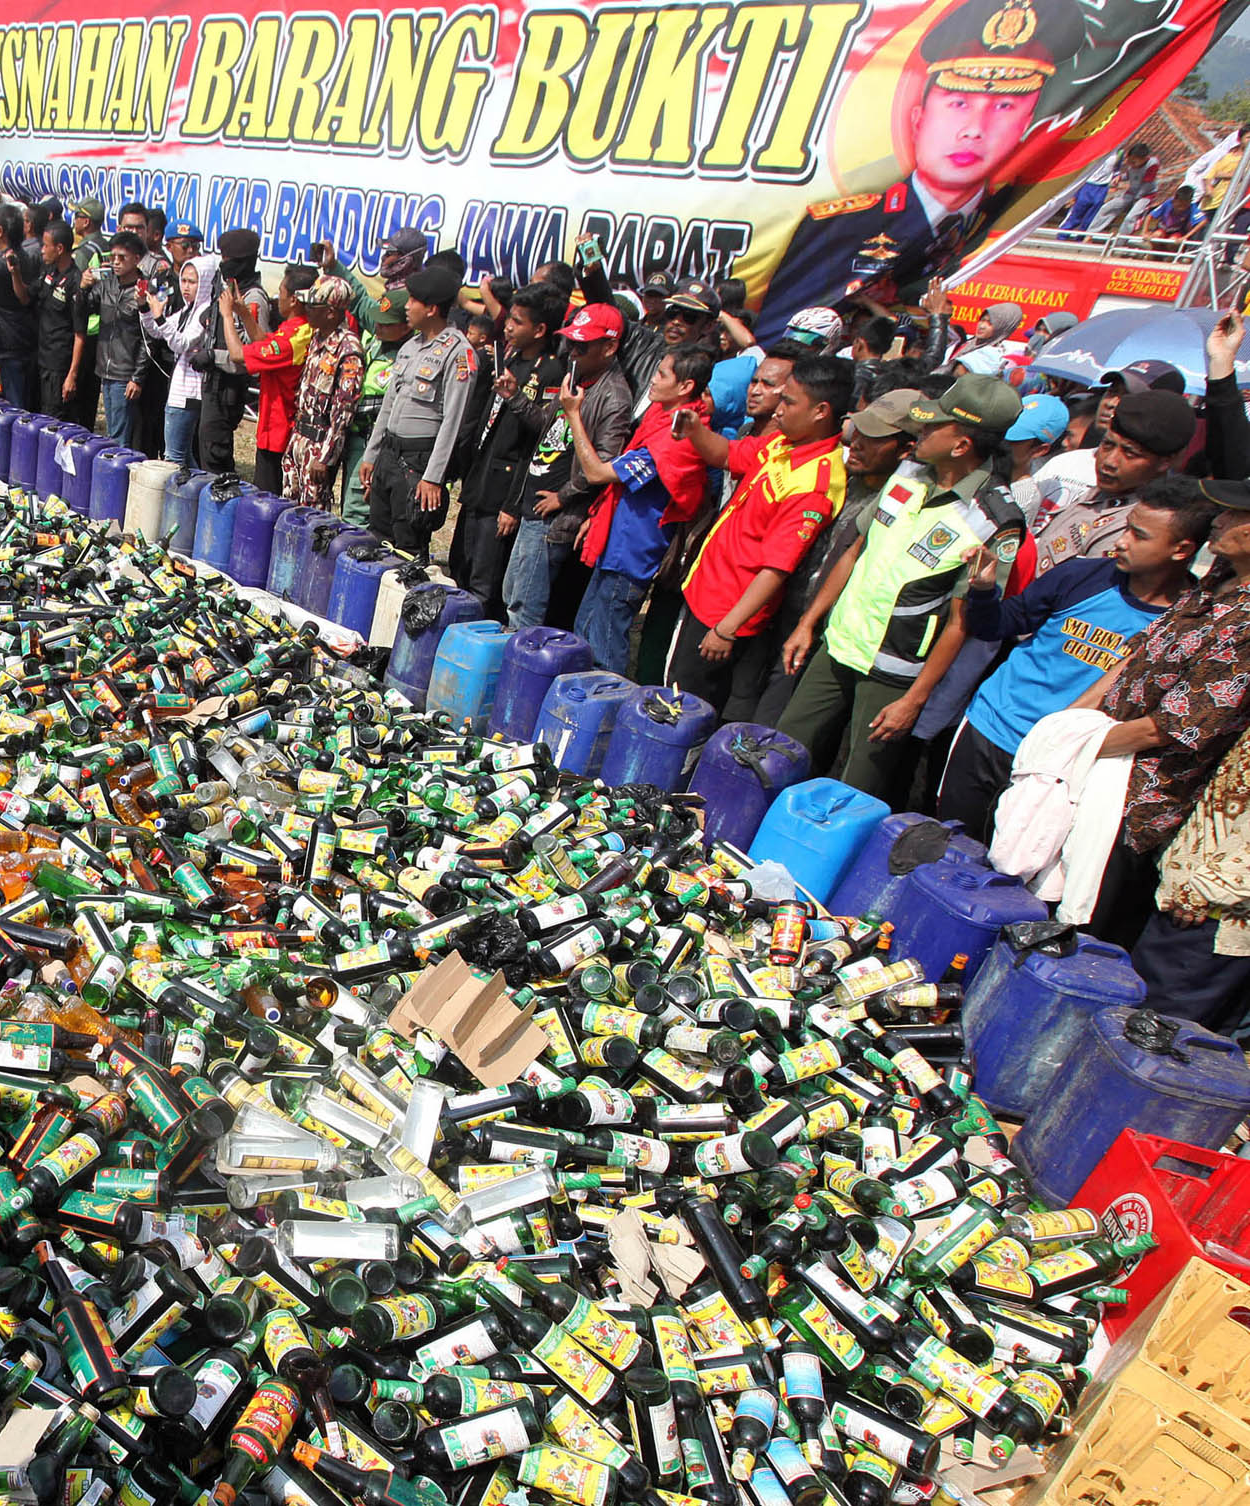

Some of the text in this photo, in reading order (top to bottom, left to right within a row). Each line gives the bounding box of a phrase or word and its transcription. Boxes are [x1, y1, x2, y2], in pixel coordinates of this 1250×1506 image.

[184, 6, 496, 158] BARANG
[491, 0, 862, 178] BUKTI
[457, 200, 567, 287] JAWA
[1111, 267, 1182, 286] CICALENGKA
[982, 283, 1069, 307] KEBAKARAN
[1060, 617, 1091, 640] SMA
[1088, 627, 1125, 651] BINA
[1133, 1202, 1148, 1237] PILSENE
[258, 1390, 295, 1415] INTISARI
